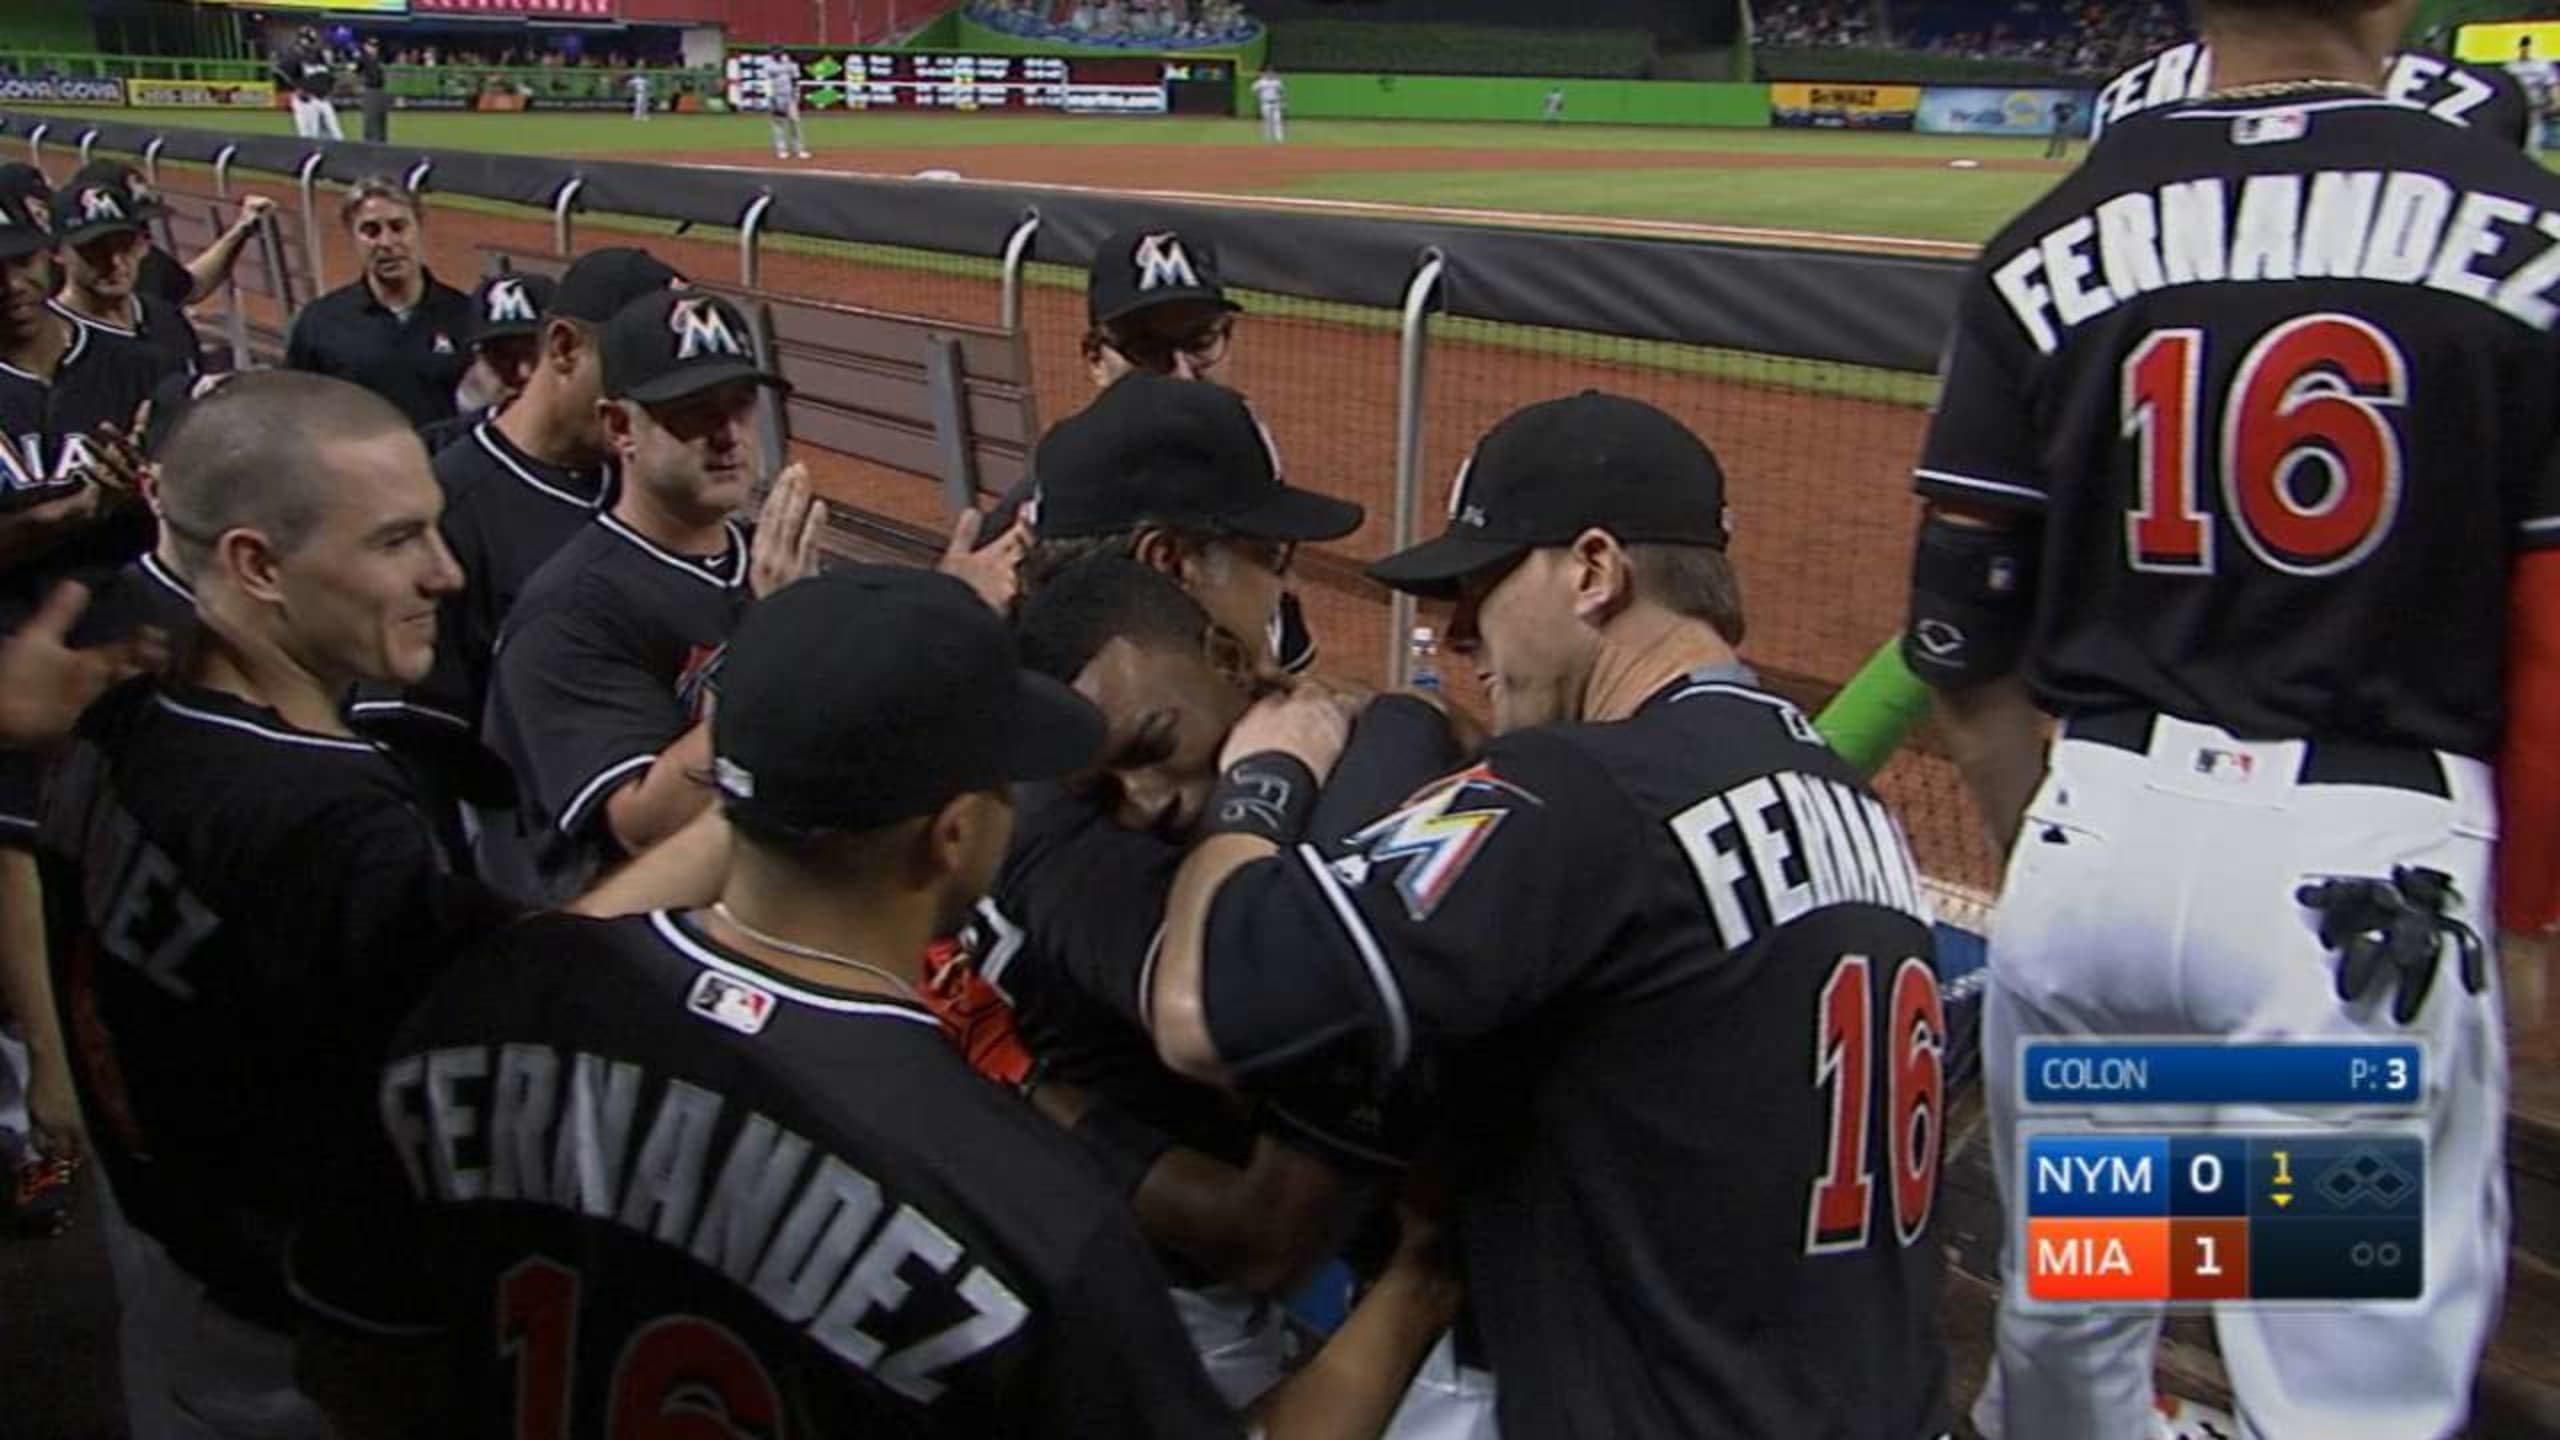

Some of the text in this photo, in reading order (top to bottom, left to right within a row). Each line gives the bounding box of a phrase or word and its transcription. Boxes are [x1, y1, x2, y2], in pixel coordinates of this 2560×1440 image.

[1991, 170, 2560, 358] FERNANDEZ
[2120, 312, 2408, 576] 16
[379, 1042, 1033, 1403] FERNANDEZ
[1805, 953, 1948, 1256] 16
